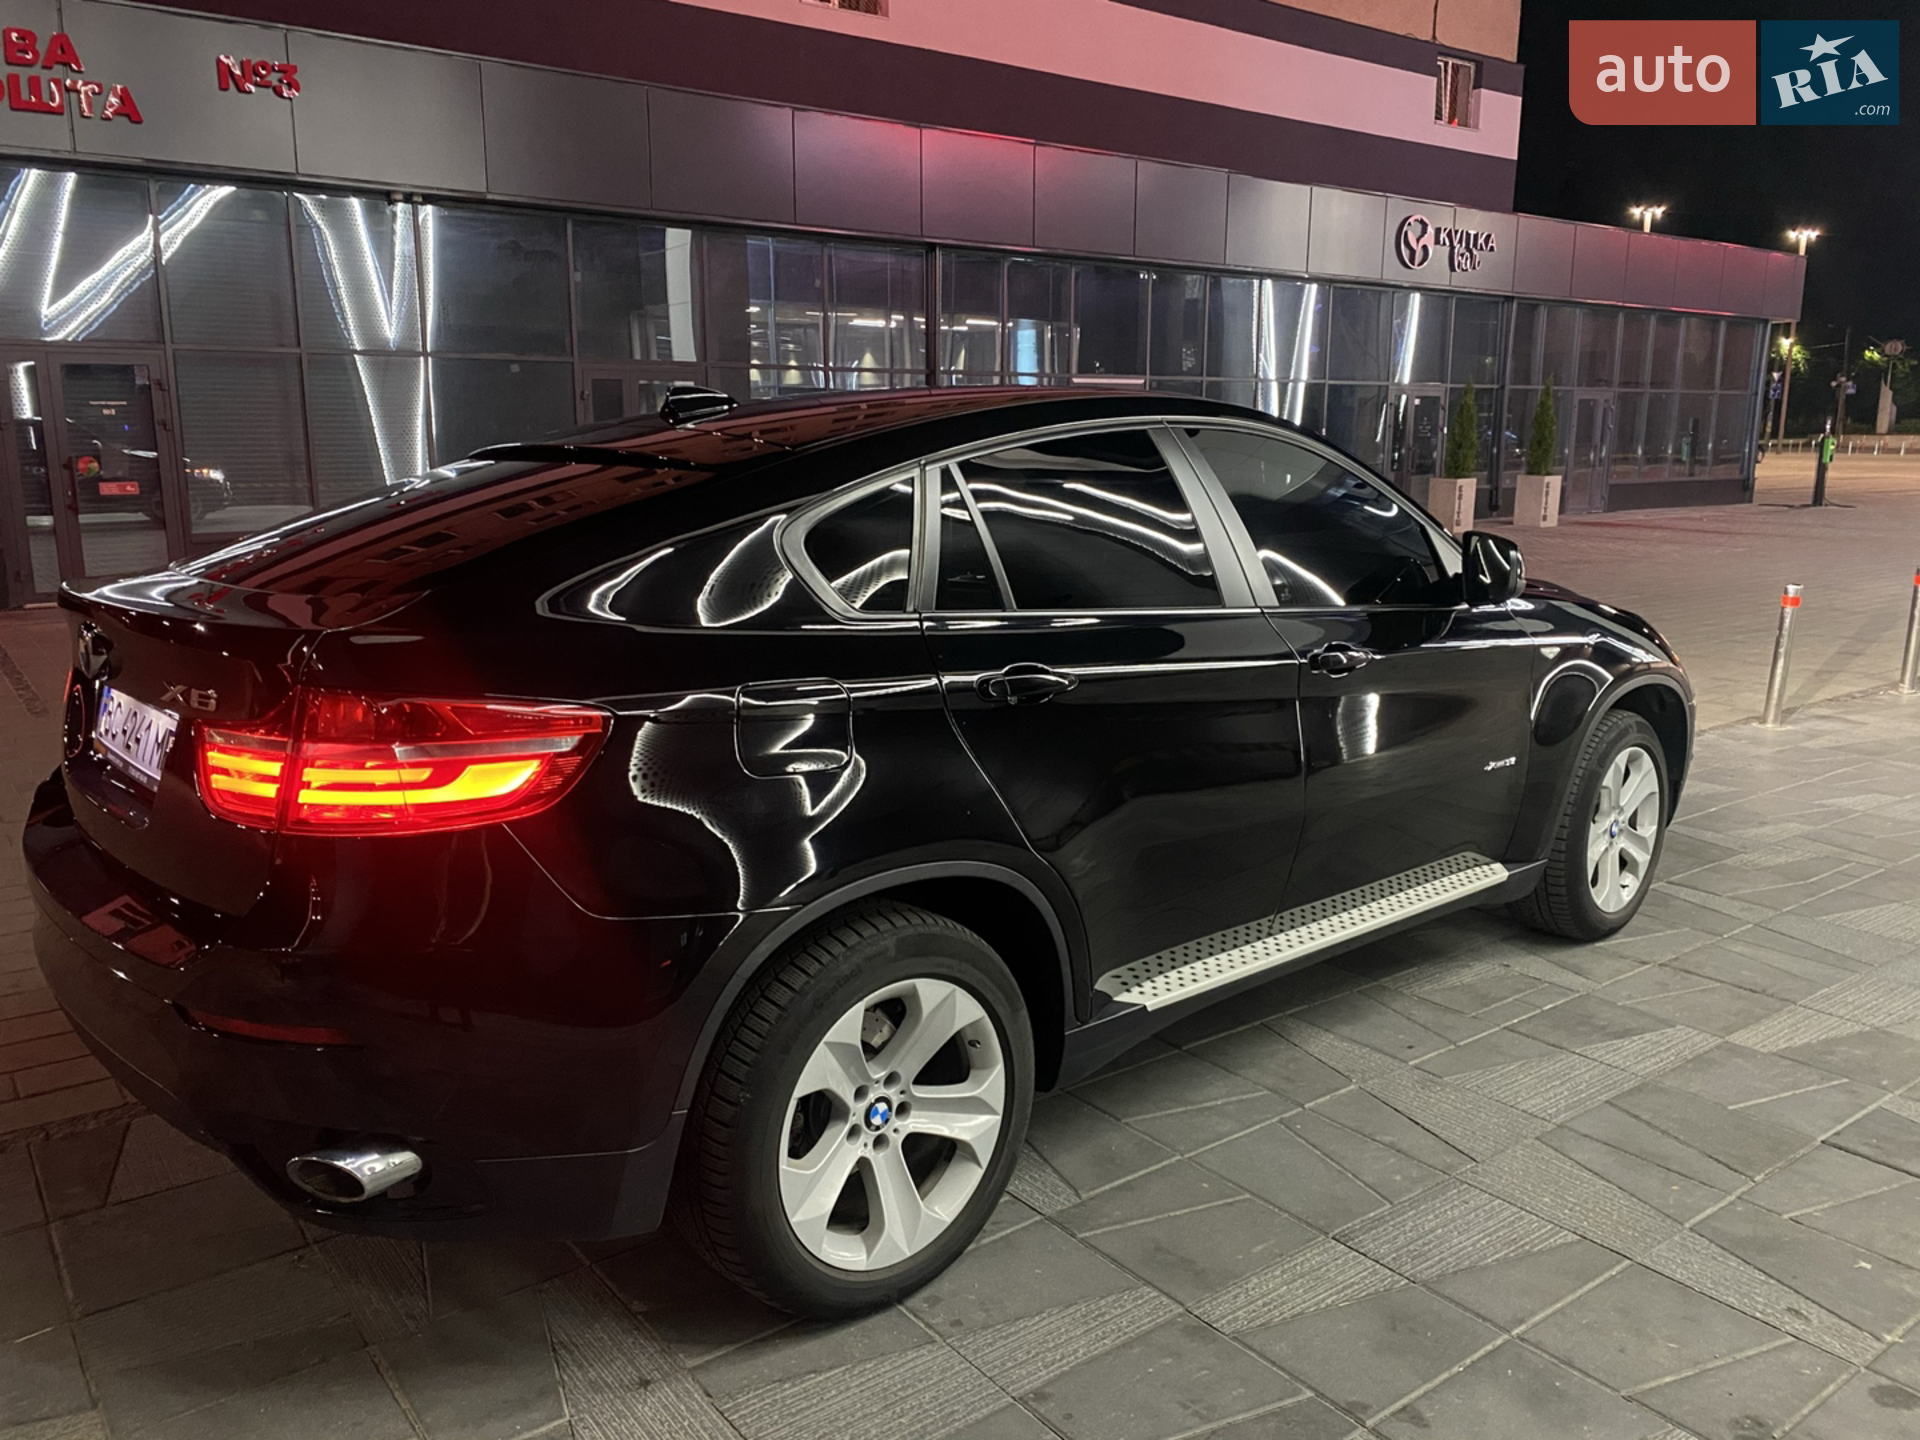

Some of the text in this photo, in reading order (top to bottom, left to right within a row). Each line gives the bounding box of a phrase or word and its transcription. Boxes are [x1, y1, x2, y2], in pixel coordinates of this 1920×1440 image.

[0, 72, 144, 124] ШТА
[160, 681, 218, 712] X6
[122, 706, 153, 763] 4241
[149, 721, 169, 771] M
